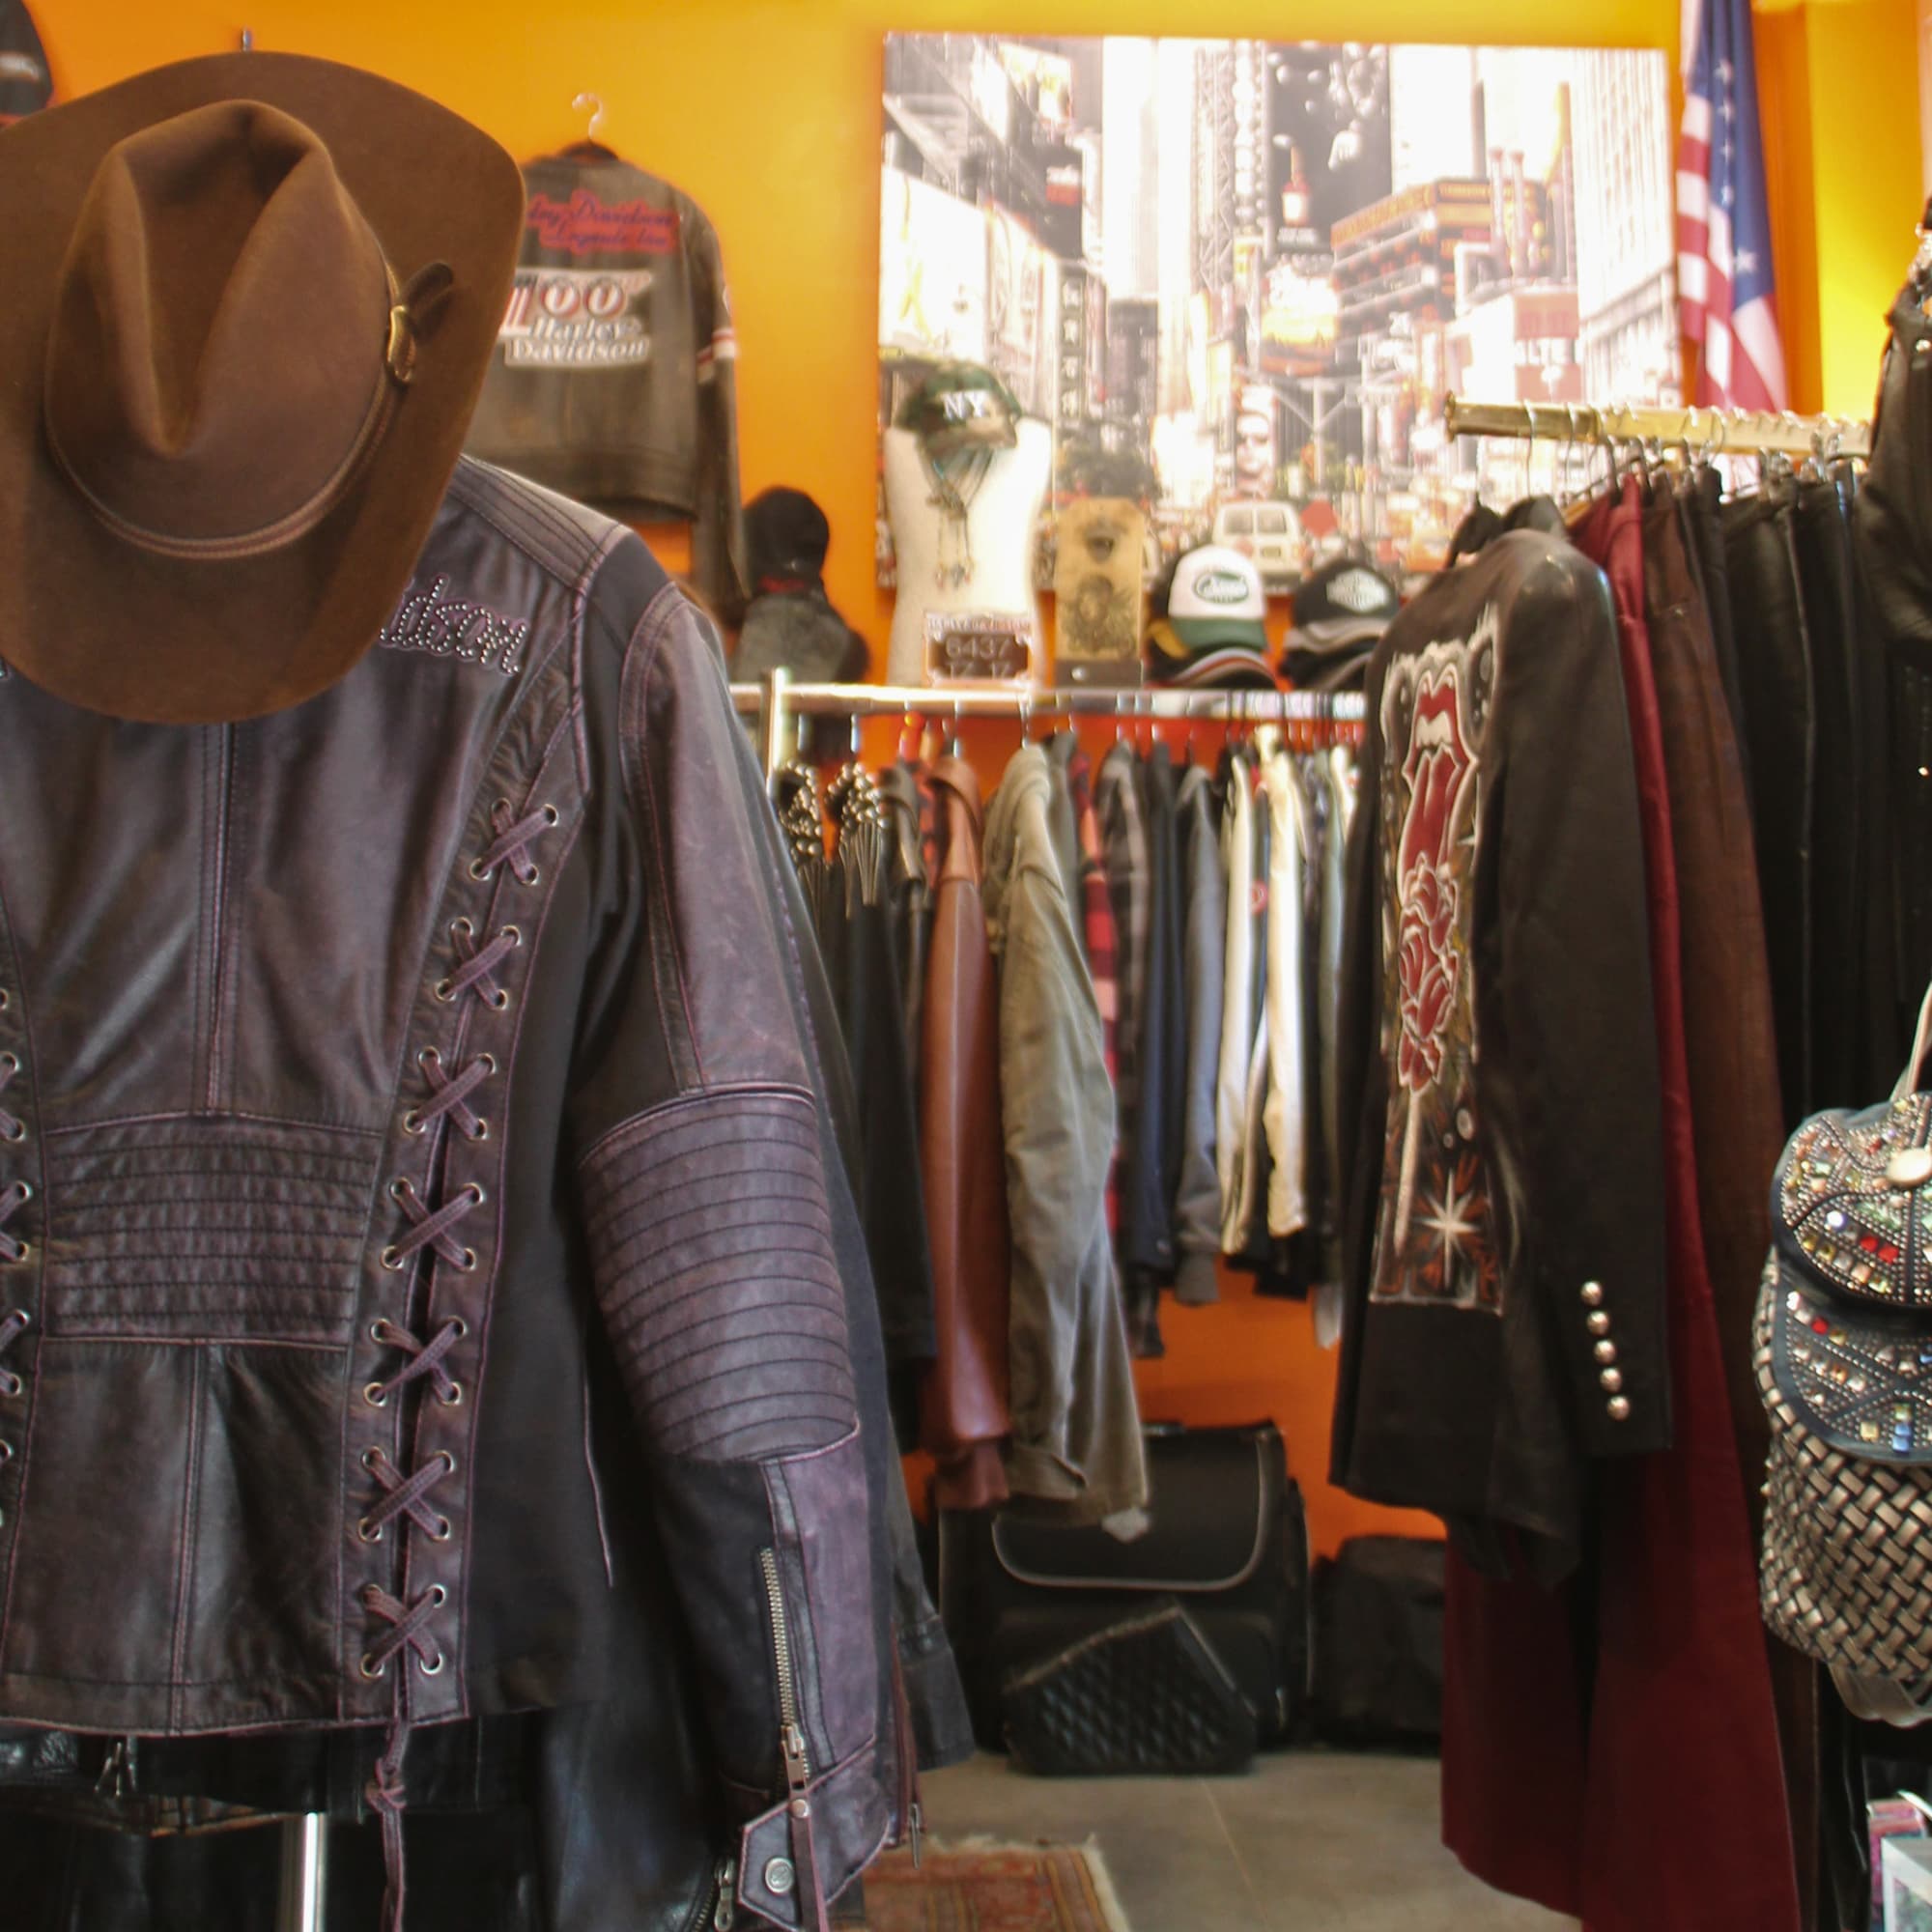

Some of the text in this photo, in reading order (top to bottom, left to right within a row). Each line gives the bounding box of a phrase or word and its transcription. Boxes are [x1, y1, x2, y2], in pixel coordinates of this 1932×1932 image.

[532, 317, 623, 340] Harley
[511, 338, 645, 362] Davidson
[940, 389, 988, 421] NY
